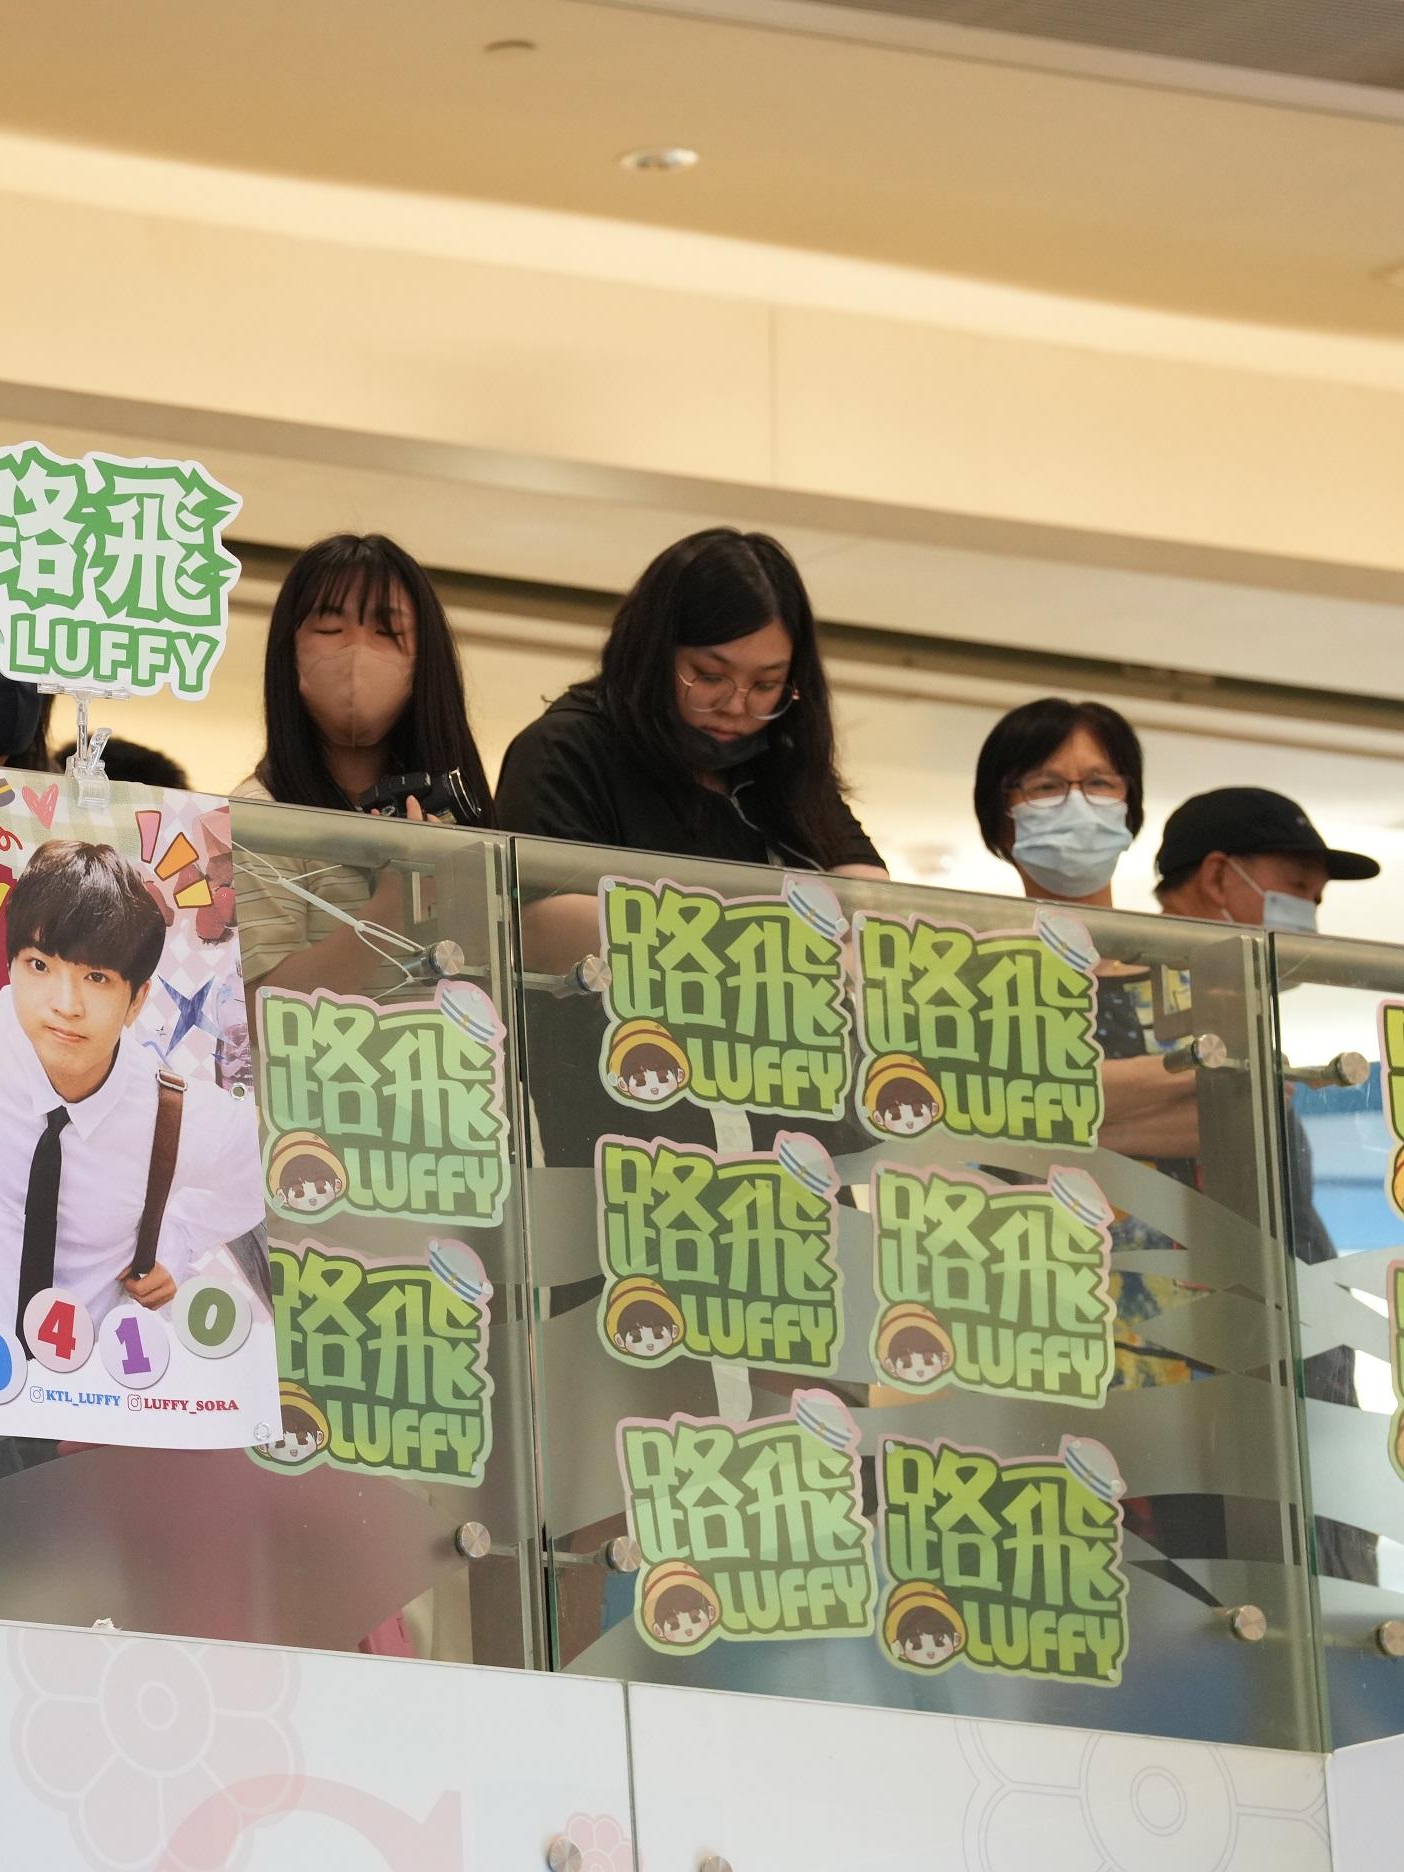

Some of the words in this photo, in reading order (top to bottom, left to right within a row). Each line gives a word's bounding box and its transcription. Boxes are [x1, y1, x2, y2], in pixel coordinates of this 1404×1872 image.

[9, 612, 220, 693] LUFFY
[686, 1038, 845, 1113] LUFFY
[942, 1073, 1097, 1144] LUFFY
[344, 1148, 498, 1214] LUFFY
[680, 1295, 835, 1369] LUFFY
[953, 1325, 1108, 1394] LUFFY
[46, 1389, 121, 1406] KTL_LUFFY
[144, 1398, 239, 1415] LUFFY_SORA
[327, 1400, 481, 1474] LUFFY
[720, 1563, 868, 1634] LUFFY
[968, 1604, 1124, 1677] LUFFY
